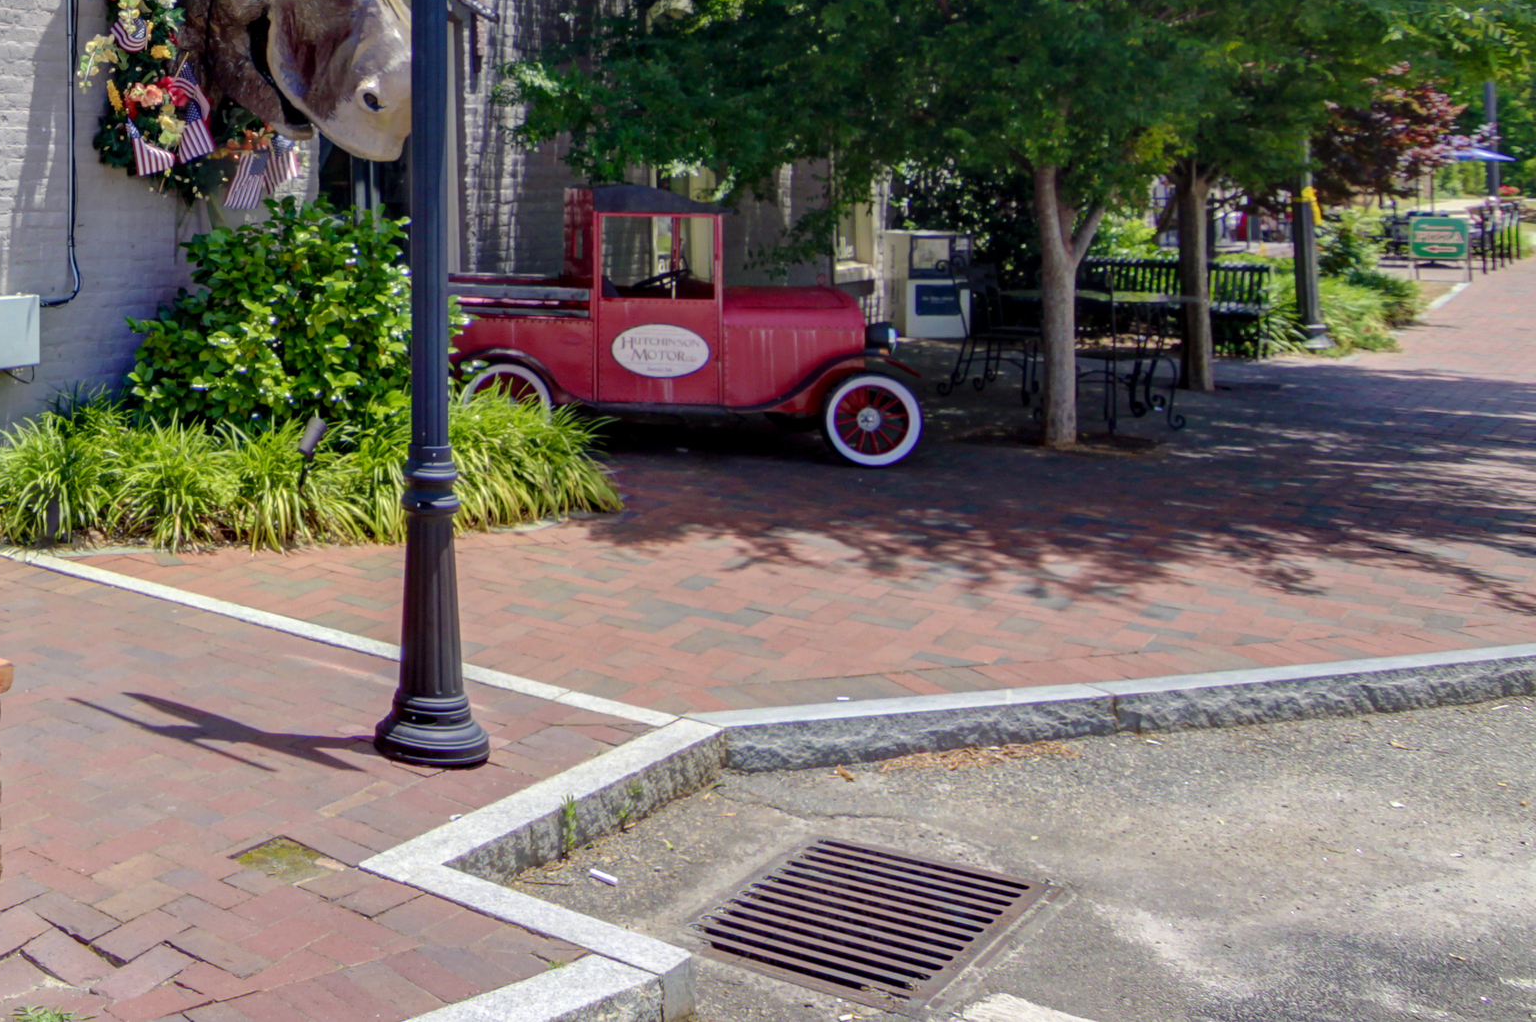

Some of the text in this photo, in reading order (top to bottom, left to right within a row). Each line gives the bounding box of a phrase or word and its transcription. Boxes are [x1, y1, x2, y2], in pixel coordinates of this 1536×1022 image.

[1414, 231, 1464, 243] PIZZA
[621, 336, 700, 349] HUTCHINSON
[630, 348, 685, 361] MOTOR
